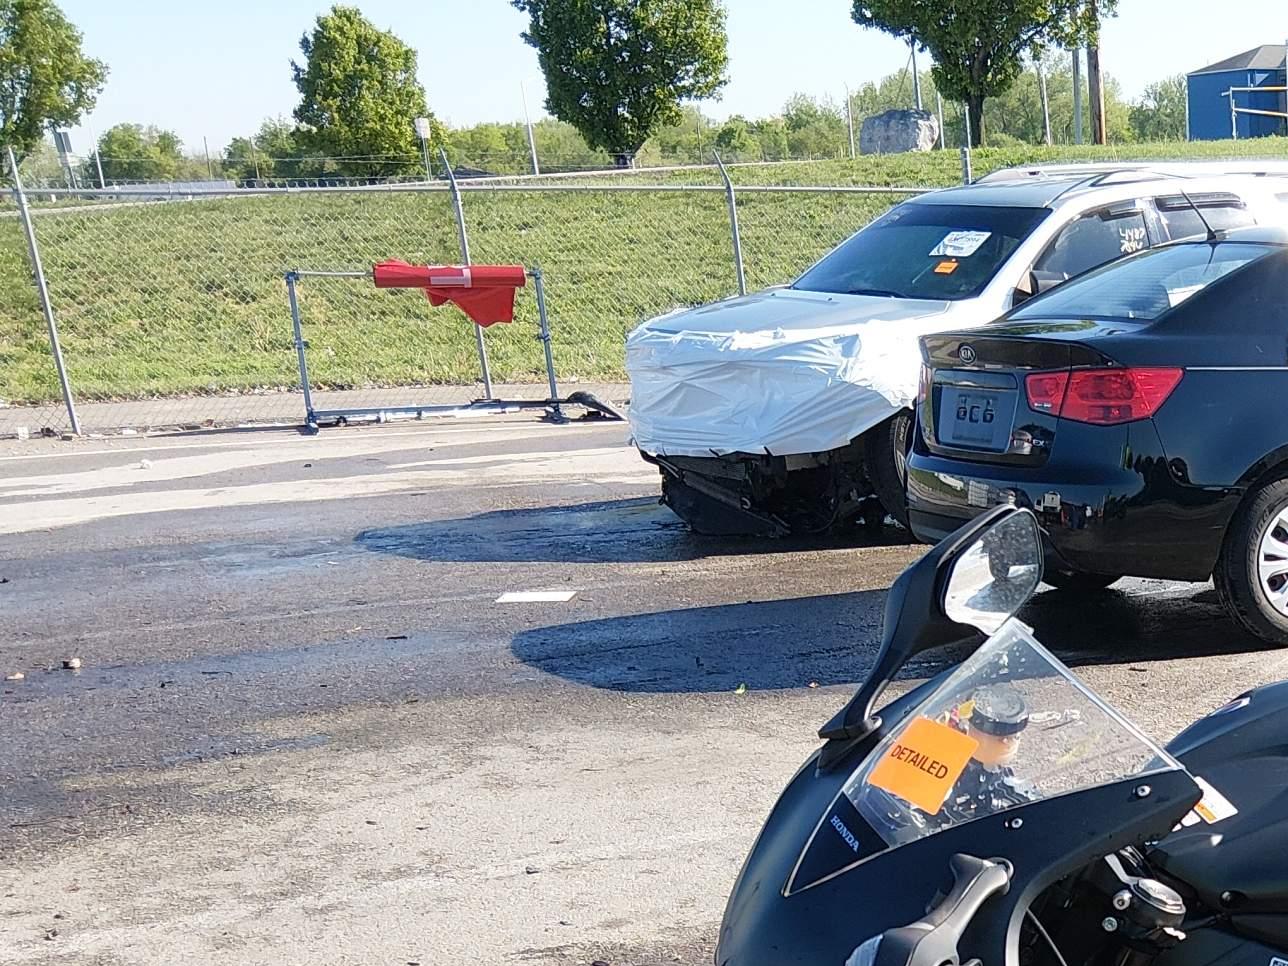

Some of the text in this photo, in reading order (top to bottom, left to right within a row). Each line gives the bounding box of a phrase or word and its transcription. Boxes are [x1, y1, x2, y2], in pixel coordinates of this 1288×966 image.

[1032, 439, 1046, 447] EX
[890, 745, 949, 780] DETAILED
[830, 815, 860, 853] HONDA
